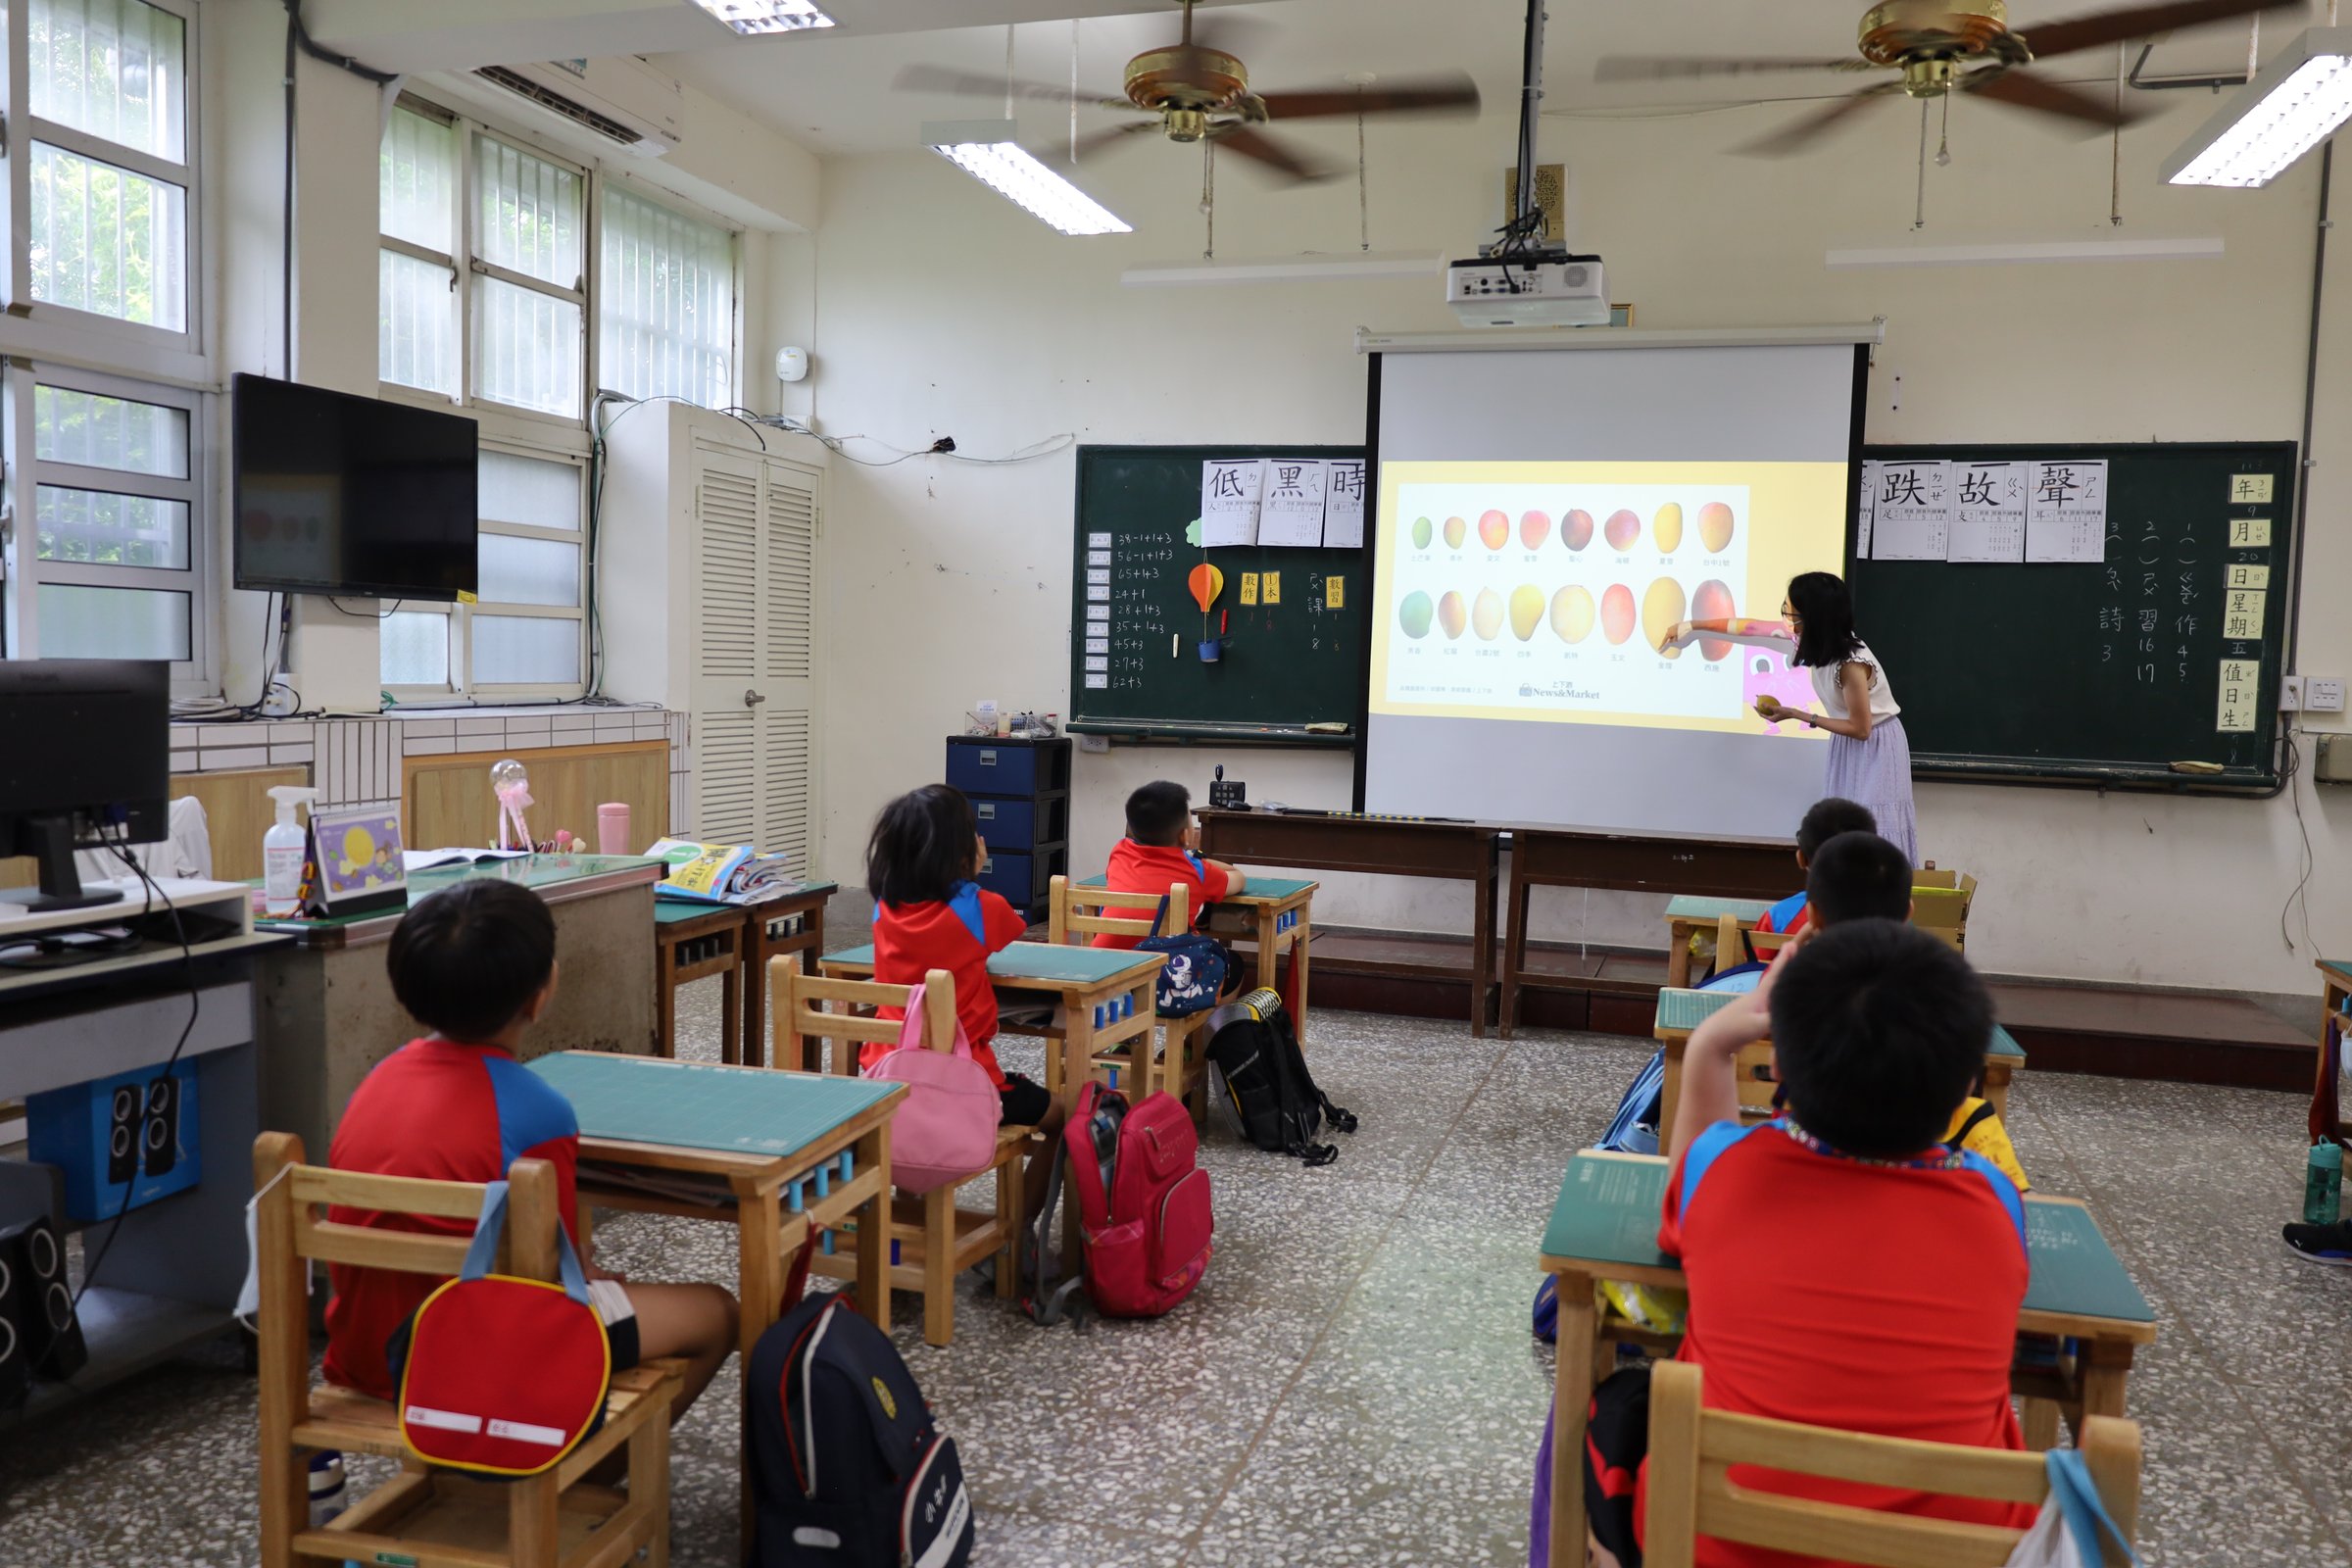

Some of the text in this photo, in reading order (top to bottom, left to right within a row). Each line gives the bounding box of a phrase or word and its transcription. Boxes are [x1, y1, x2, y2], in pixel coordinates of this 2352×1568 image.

[1208, 467, 1244, 498] 低
[1271, 466, 1303, 498] 黑
[1334, 464, 1365, 501] 時
[1882, 468, 1927, 506] 跌
[1959, 471, 2001, 506] 故
[2037, 466, 2080, 510] 聲
[2085, 477, 2096, 498] ㄕㄥ
[2235, 479, 2254, 500] 年
[2248, 506, 2256, 516] 9
[2234, 522, 2248, 542] 月
[2238, 552, 2258, 562] 20
[2235, 568, 2246, 584] 日
[2176, 613, 2198, 635] 作
[2228, 593, 2248, 636] 星期
[1114, 638, 1144, 650] 45+3
[2139, 638, 2154, 652] 16
[2177, 645, 2187, 659] 4
[2231, 642, 2246, 655] 五
[1113, 676, 1142, 688] 62+3
[2137, 663, 2154, 682] 17
[1533, 687, 1599, 700] News&Market
[2222, 662, 2243, 727] 值日生
